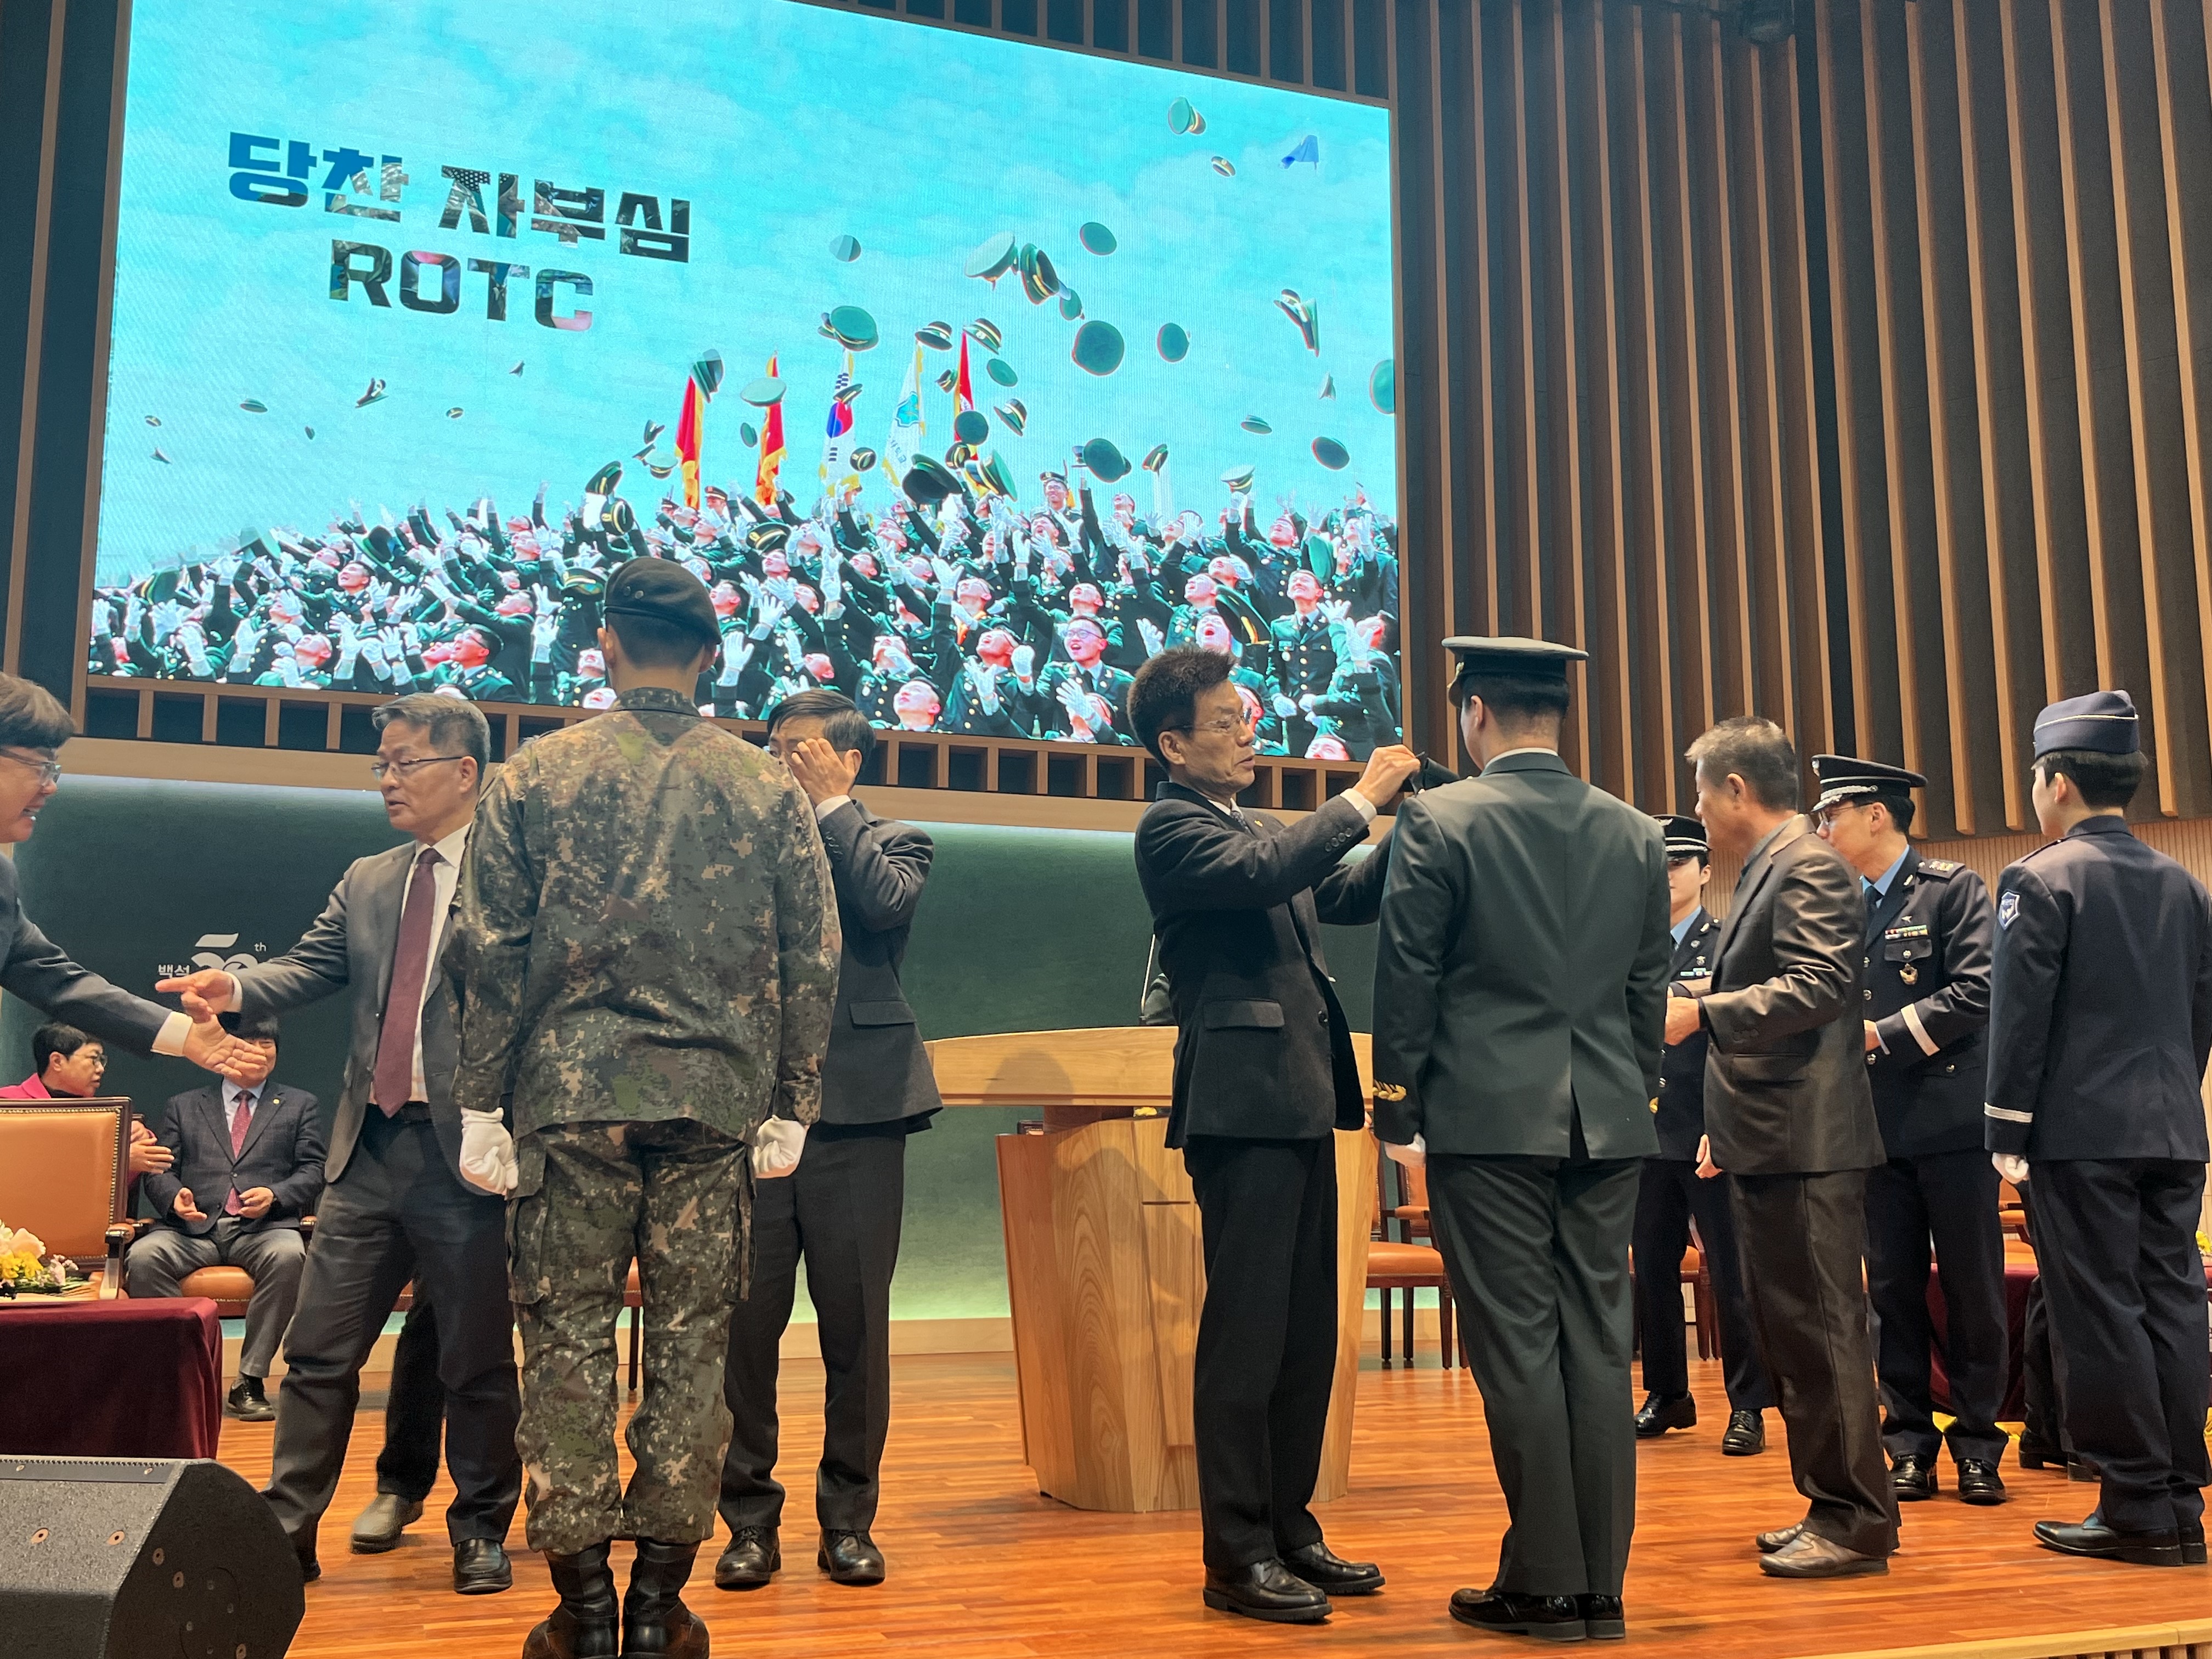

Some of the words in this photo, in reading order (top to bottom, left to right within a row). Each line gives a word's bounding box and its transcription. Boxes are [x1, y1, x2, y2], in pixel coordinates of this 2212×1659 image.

[228, 132, 409, 223] 당찬
[438, 165, 690, 263] 자부심
[329, 239, 594, 332] ROTC
[158, 964, 190, 979] 백석
